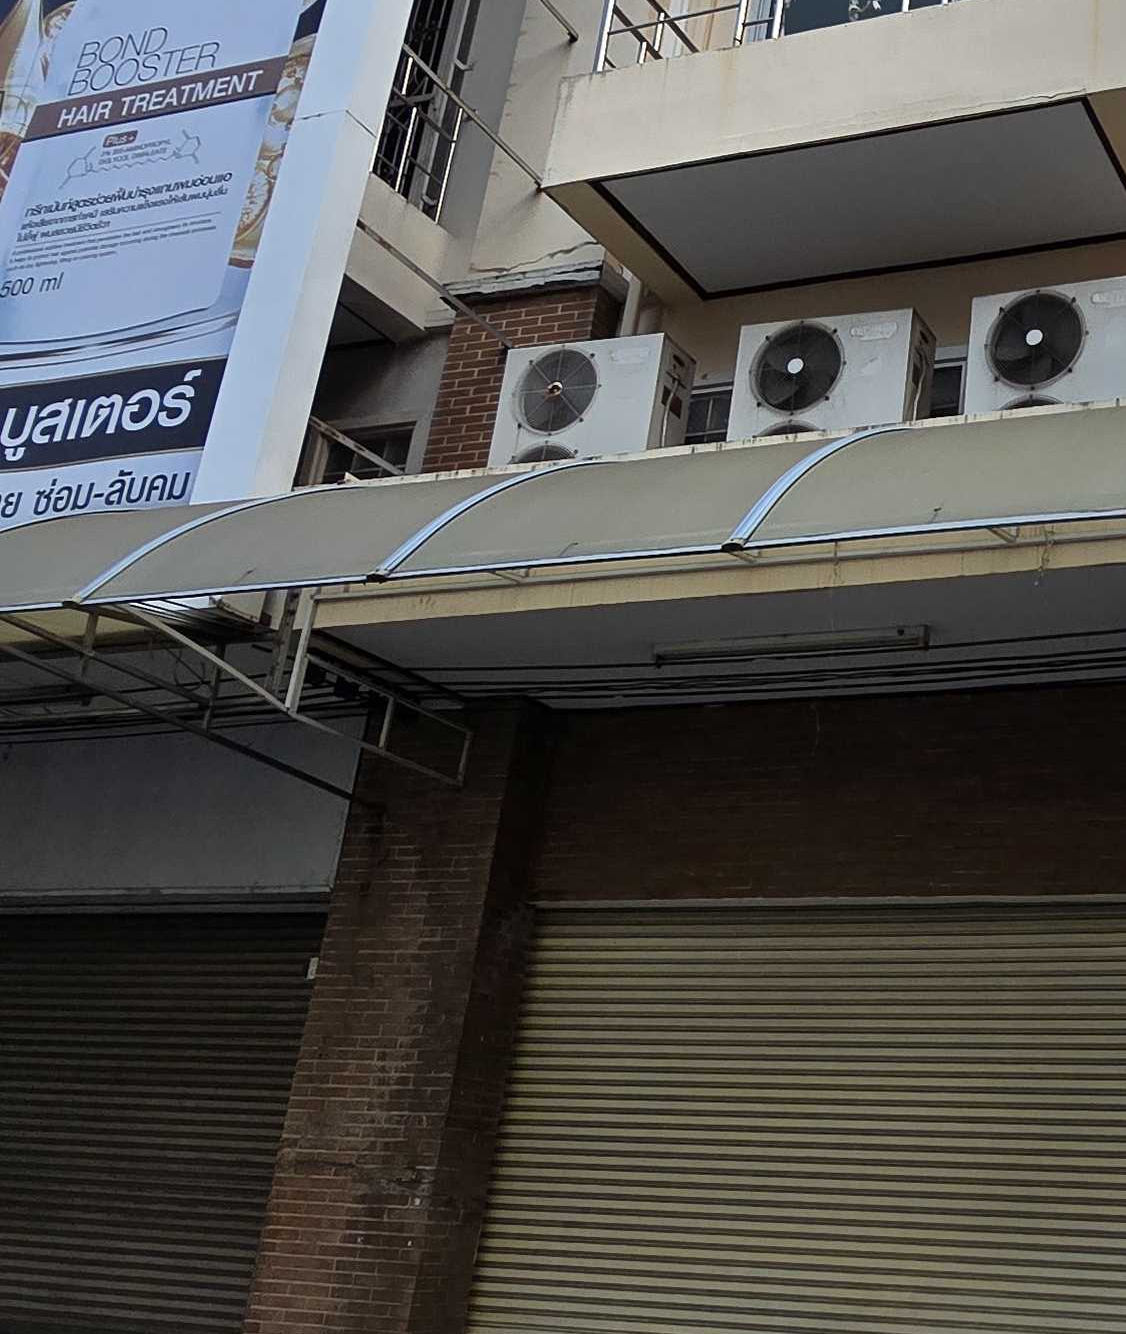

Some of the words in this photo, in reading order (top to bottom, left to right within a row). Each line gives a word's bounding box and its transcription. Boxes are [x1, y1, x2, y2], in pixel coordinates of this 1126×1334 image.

[67, 41, 221, 97] BOOSTER
[77, 26, 169, 69] BOND
[56, 99, 113, 129] HAIR
[120, 70, 264, 117] TREATMENT
[0, 276, 34, 298] 500
[39, 271, 64, 292] ml
[0, 368, 203, 462] บูสเตอร์
[33, 469, 192, 516] ซ่อม-ลับคม
